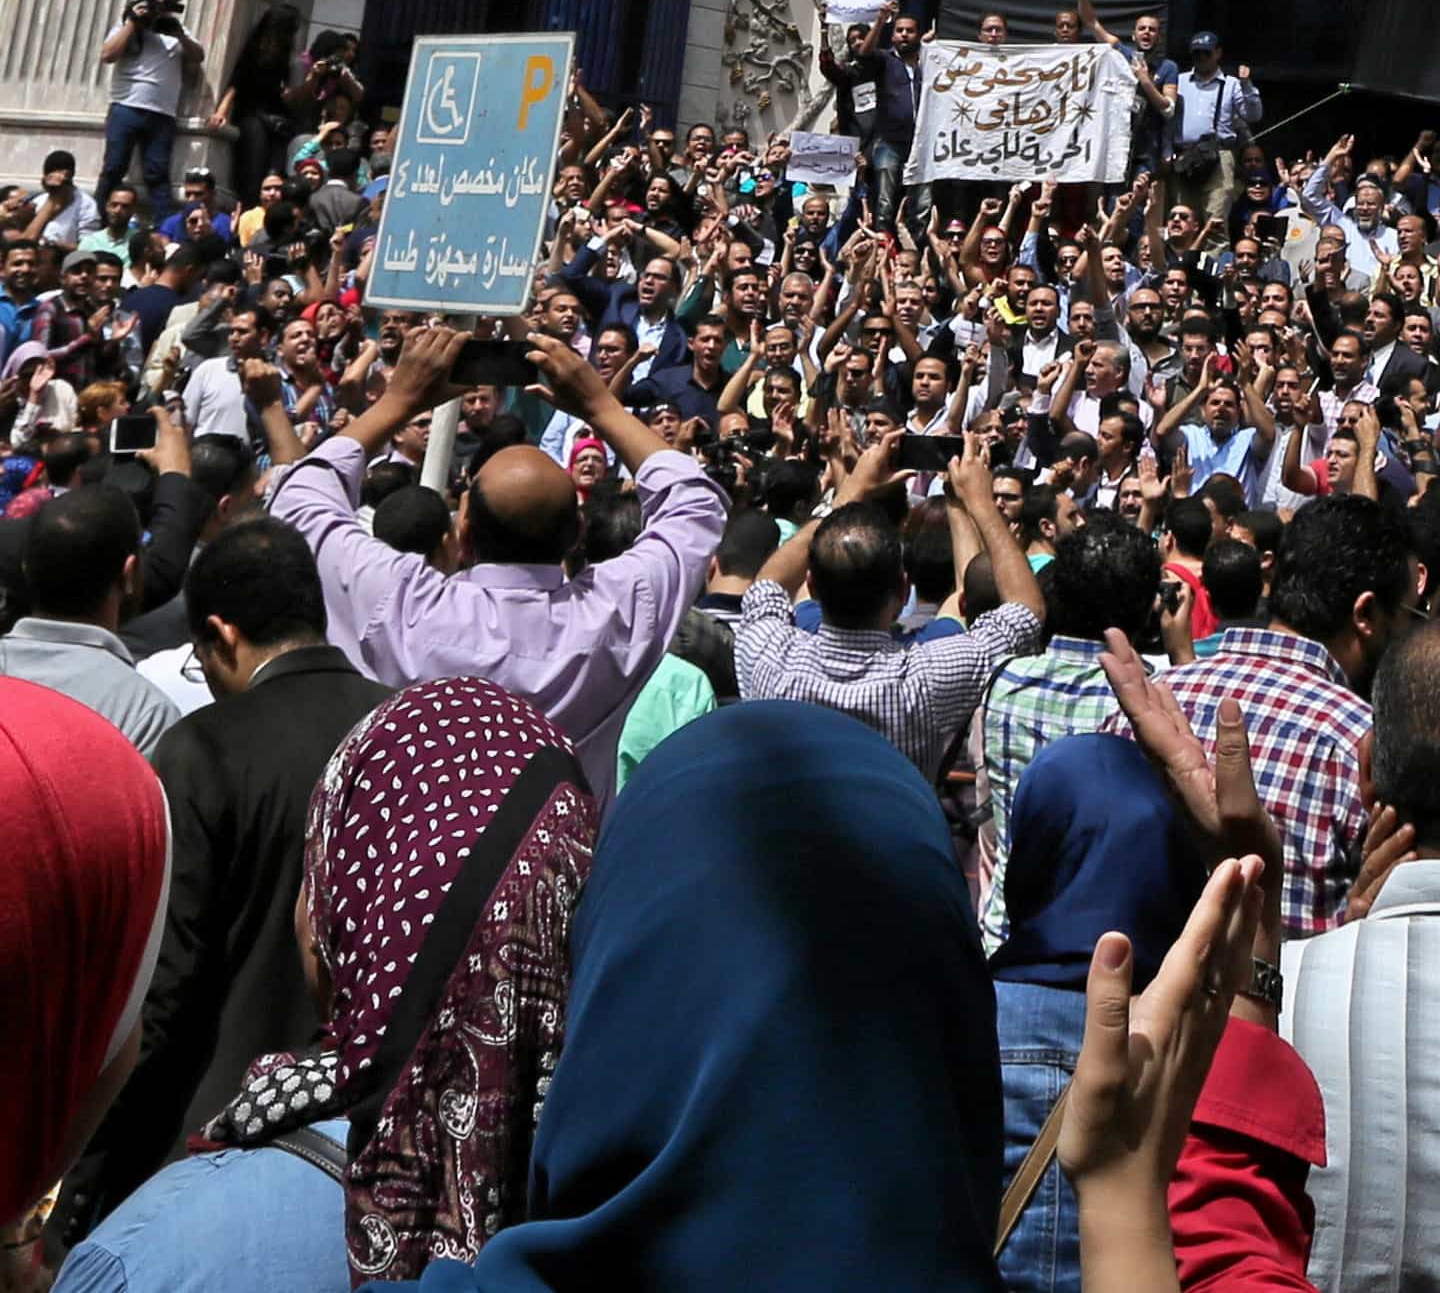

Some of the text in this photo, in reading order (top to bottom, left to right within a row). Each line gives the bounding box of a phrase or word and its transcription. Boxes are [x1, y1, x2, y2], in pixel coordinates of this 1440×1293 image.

[518, 55, 554, 132] P
[933, 124, 1092, 175] الحرية للجدعان
[393, 158, 411, 198] ٤
[440, 157, 504, 206] مخصص
[505, 156, 544, 208] مكان
[424, 232, 479, 288] مجهزة
